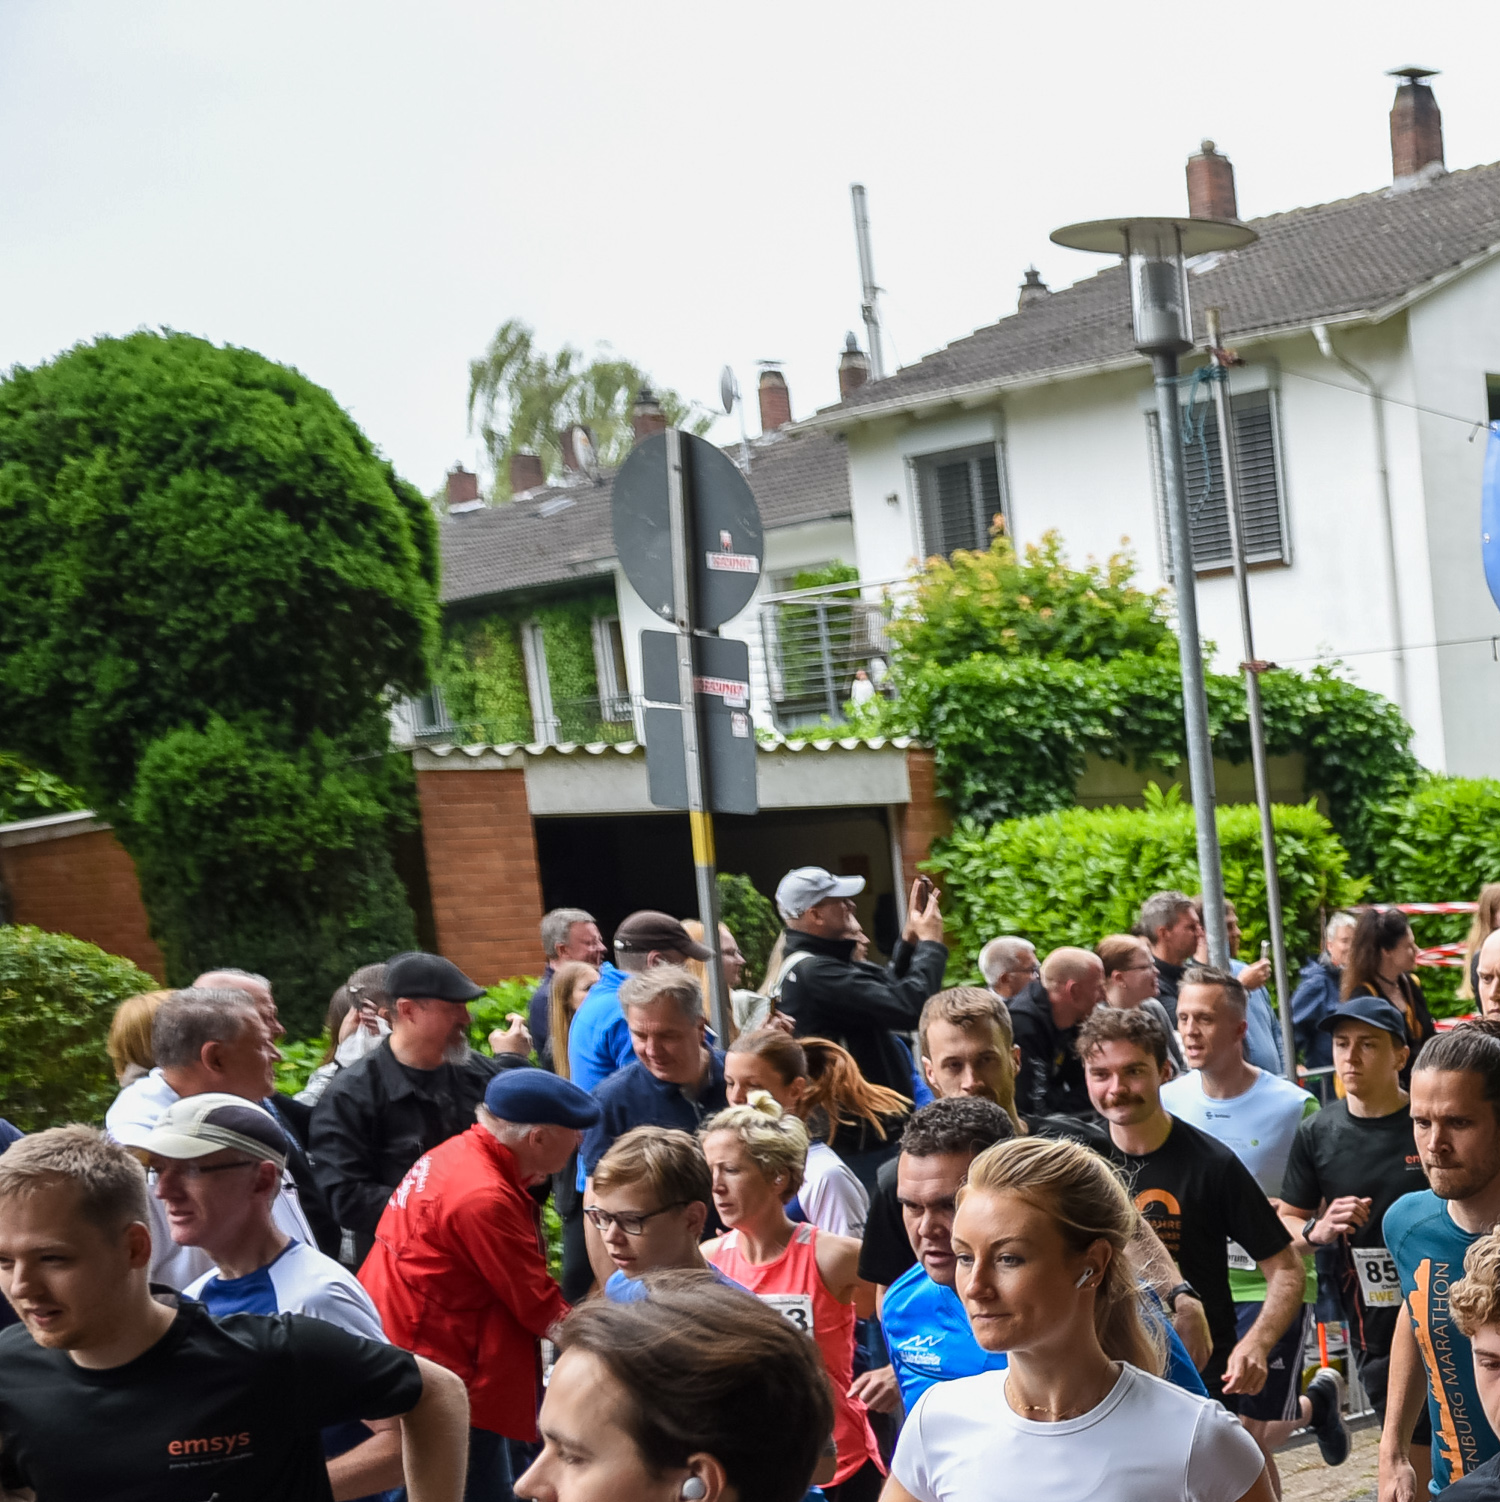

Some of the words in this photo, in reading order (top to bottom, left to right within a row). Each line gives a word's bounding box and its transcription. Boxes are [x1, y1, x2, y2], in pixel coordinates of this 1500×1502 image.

[1368, 1291, 1394, 1303] EWE
[1430, 1263, 1460, 1386] MARATHON
[168, 1432, 251, 1456] emsys
